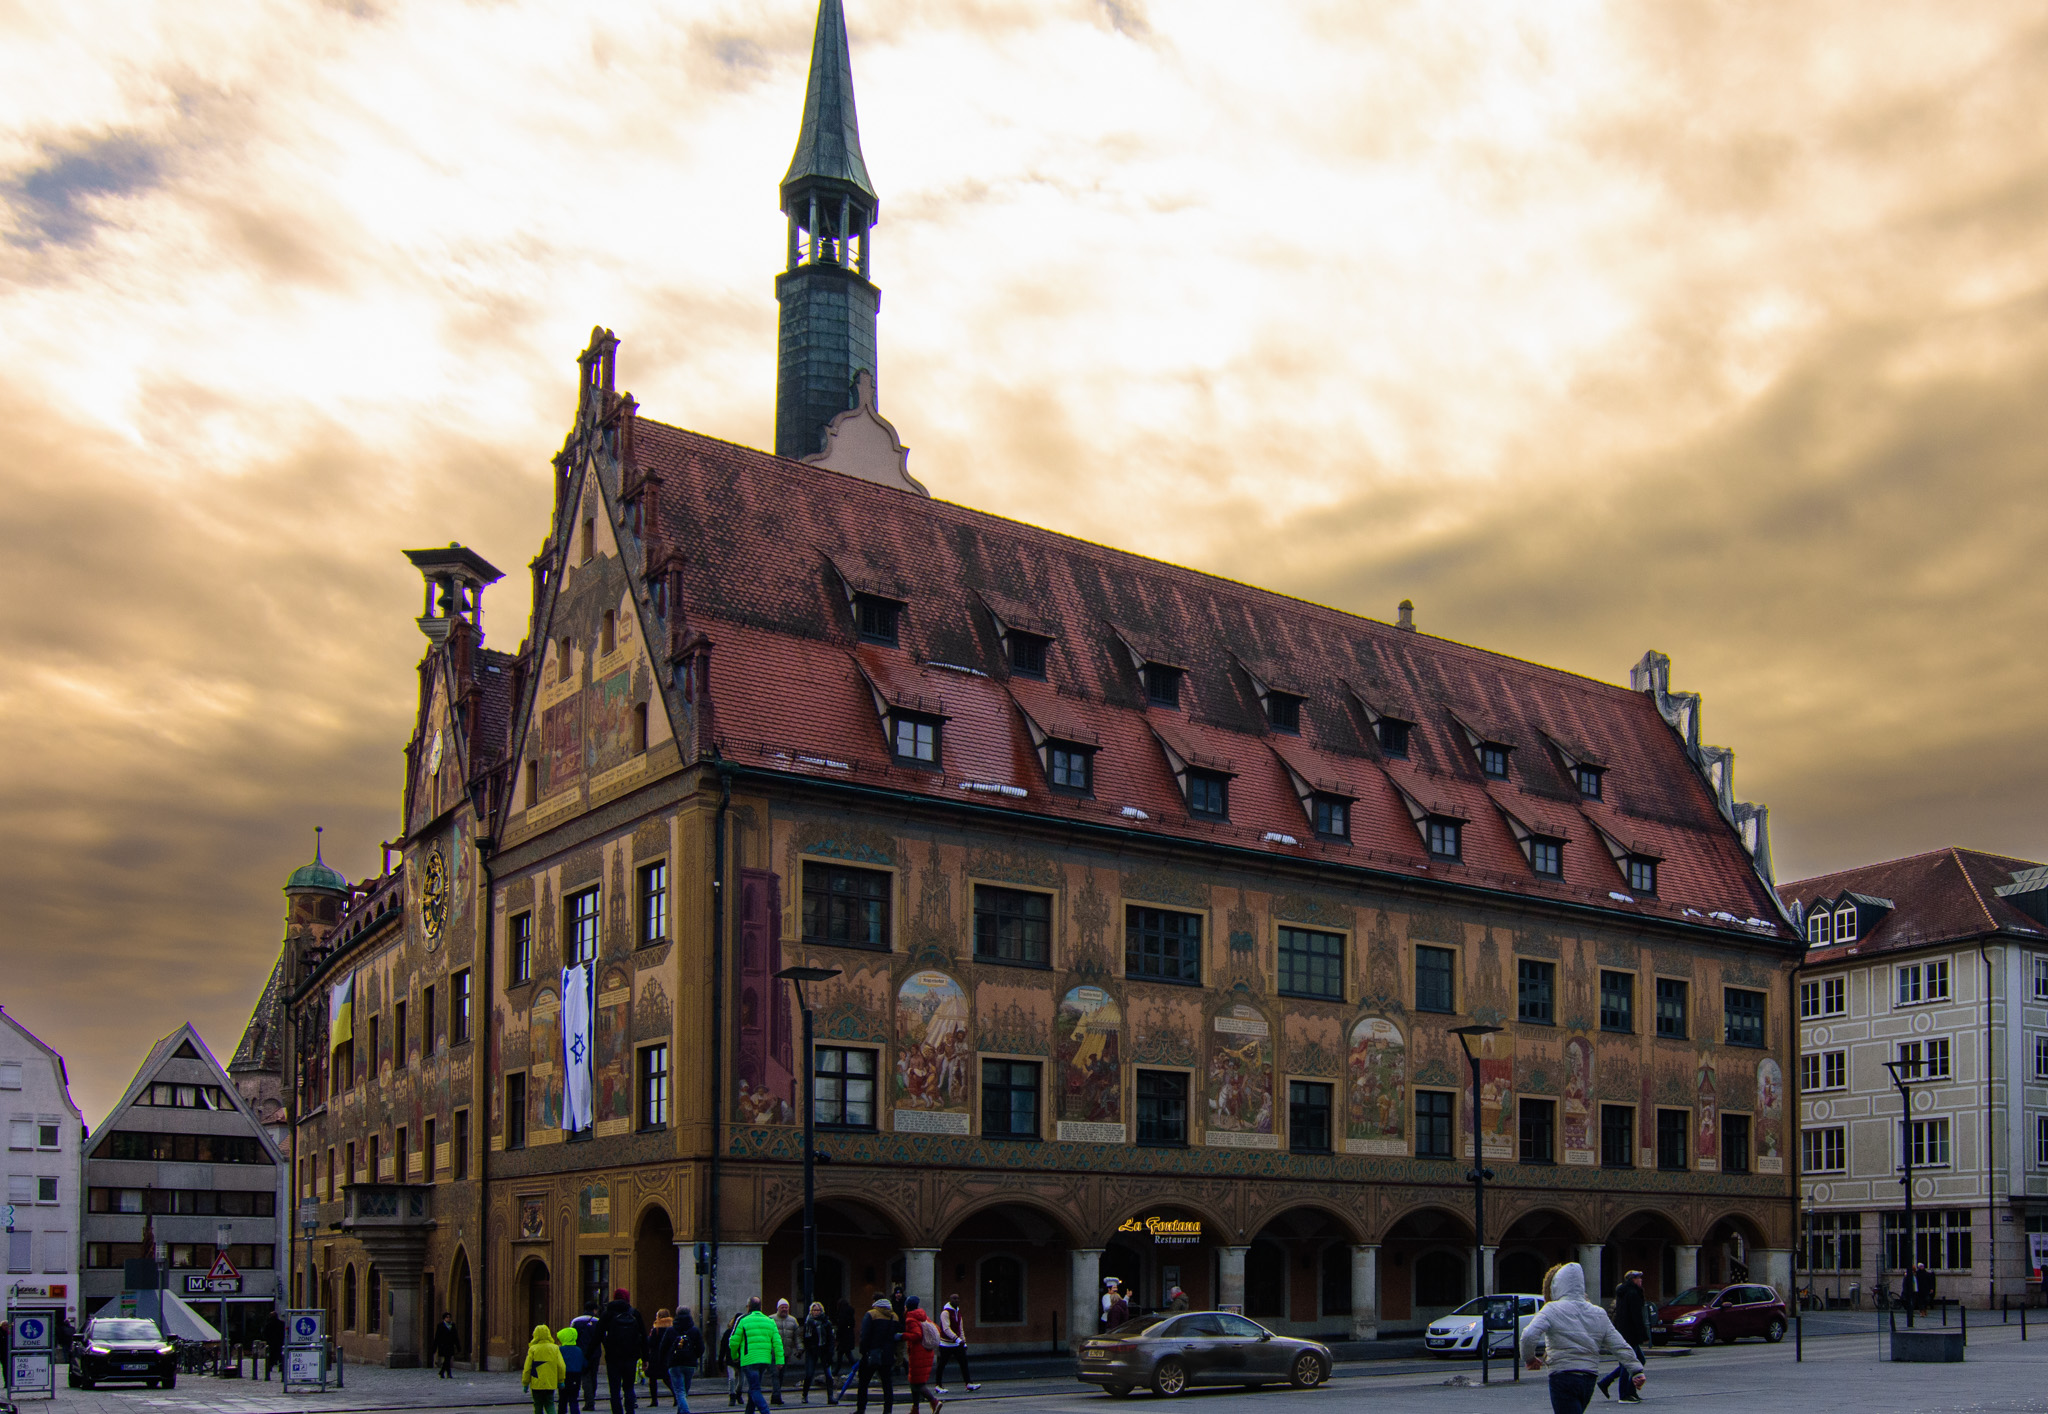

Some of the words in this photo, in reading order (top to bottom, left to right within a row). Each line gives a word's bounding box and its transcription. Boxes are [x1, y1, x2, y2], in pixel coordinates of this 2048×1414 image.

[1118, 1217, 1142, 1232] La
[1146, 1217, 1201, 1235] Fontana
[1155, 1236, 1200, 1244] Restaurant
[191, 1279, 203, 1289] M
